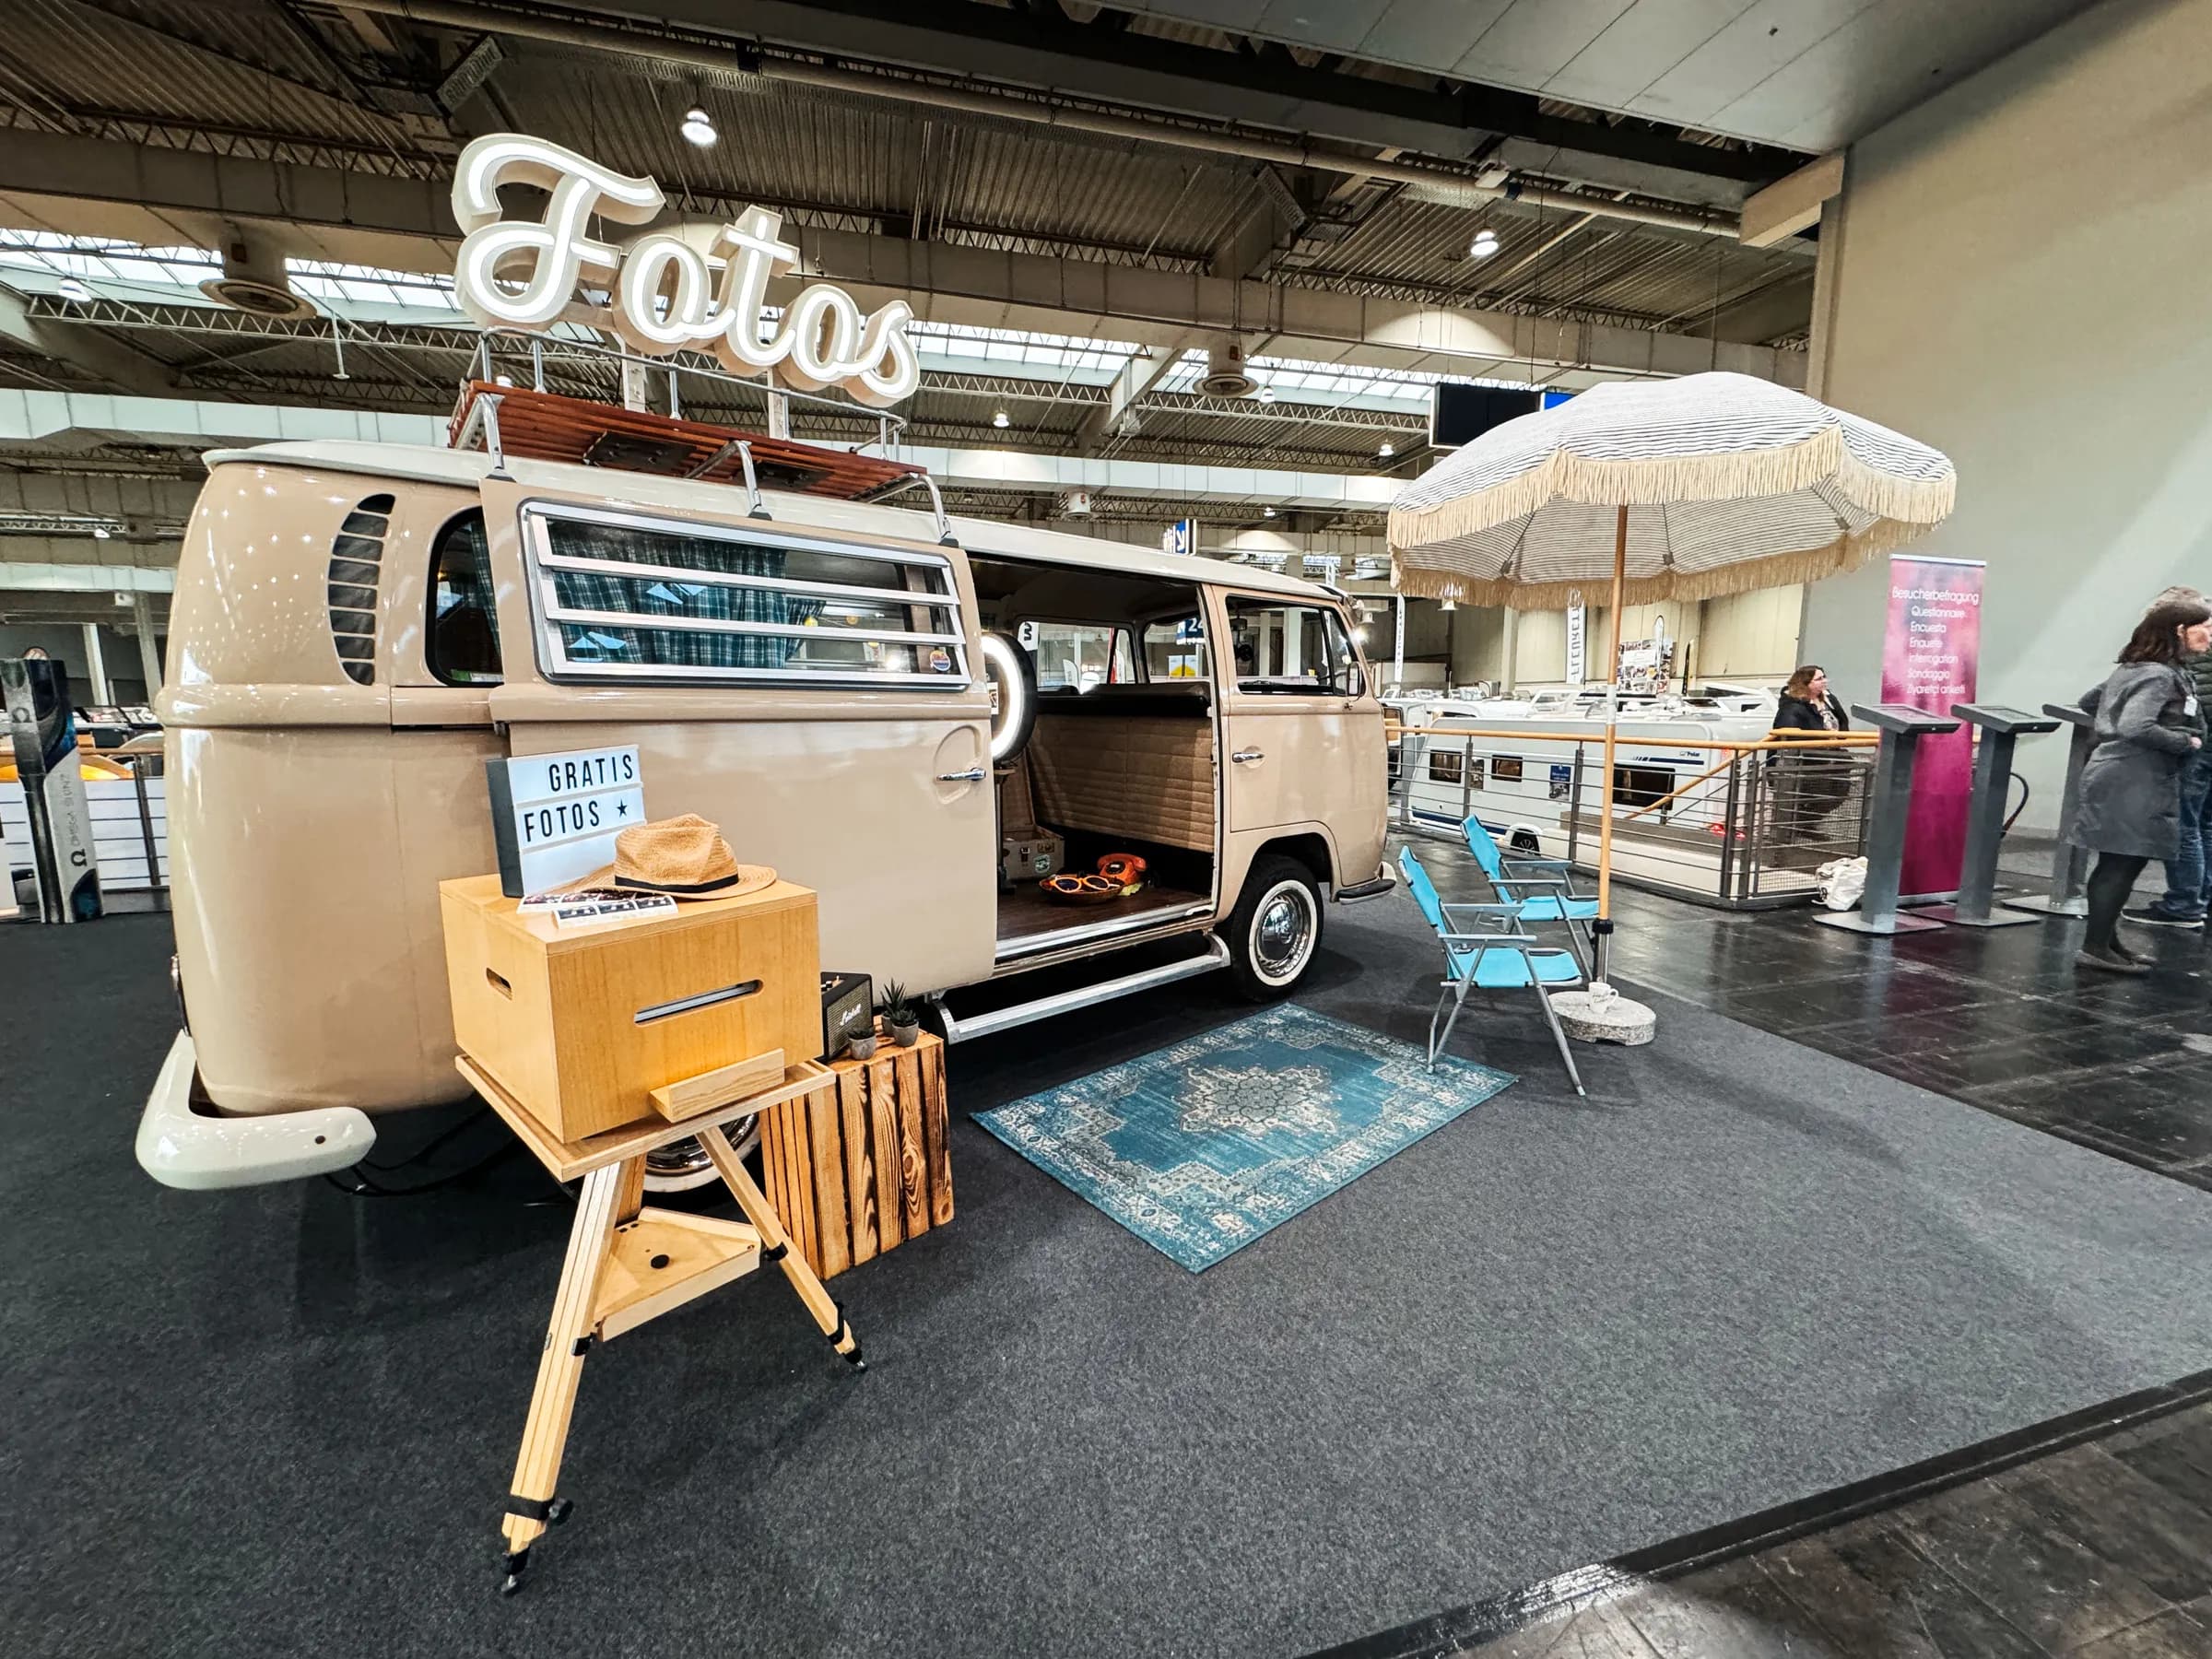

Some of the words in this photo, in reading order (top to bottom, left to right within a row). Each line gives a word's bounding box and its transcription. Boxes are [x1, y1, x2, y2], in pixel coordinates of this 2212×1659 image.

[451, 133, 920, 406] Fotos
[1892, 586, 1979, 606] Besucherbefragung
[548, 754, 634, 792] GRATIS
[524, 800, 600, 842] FOTOS
